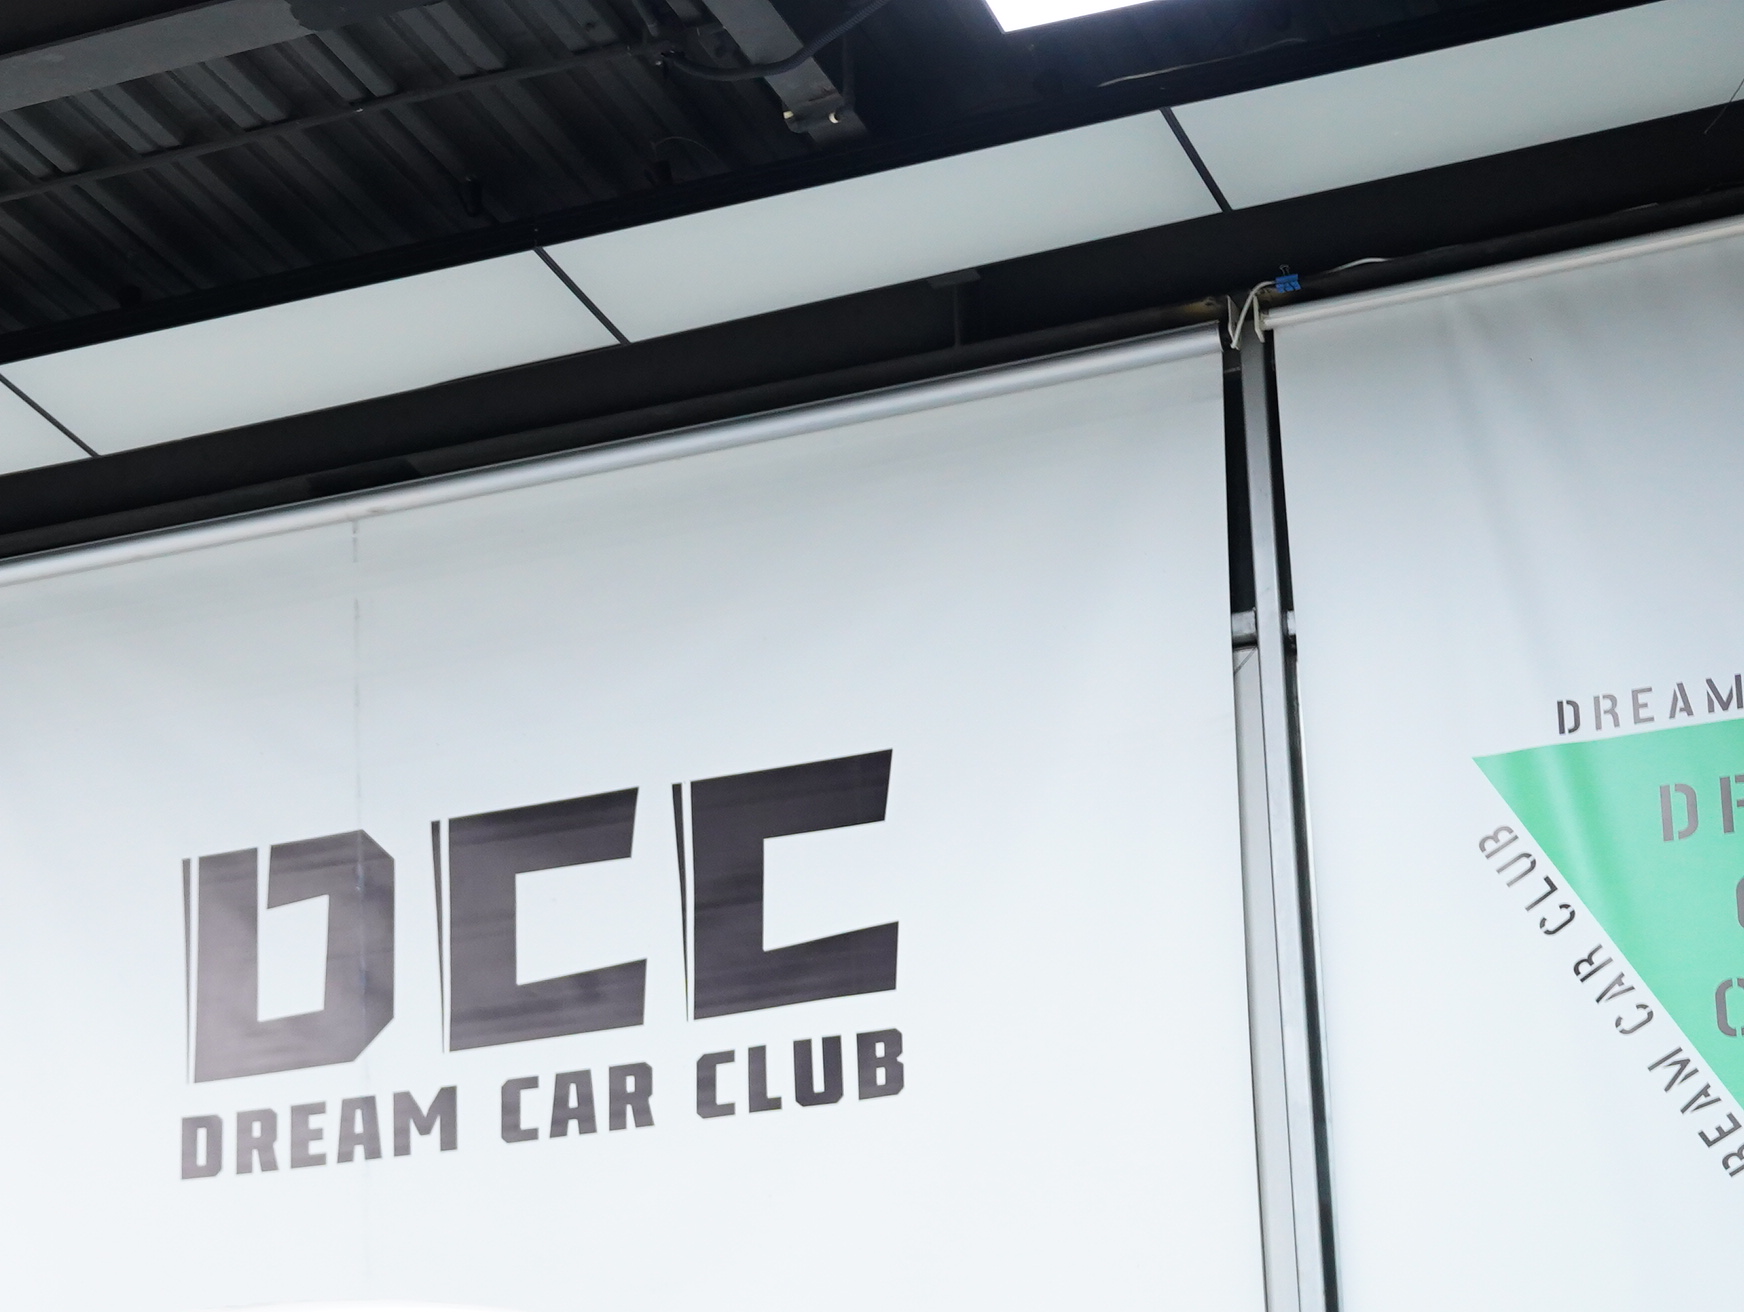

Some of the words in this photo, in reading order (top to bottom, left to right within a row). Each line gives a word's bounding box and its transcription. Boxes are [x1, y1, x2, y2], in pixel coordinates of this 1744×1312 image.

[1556, 673, 1744, 735] DREAM
[181, 748, 899, 1083] DCC
[1478, 824, 1576, 936] CLUB
[1573, 944, 1654, 1035] CAR
[181, 1085, 458, 1180] DREAM
[500, 1061, 655, 1144] CAR
[696, 1027, 905, 1119] CLUB
[1647, 1046, 1744, 1178] REAM
